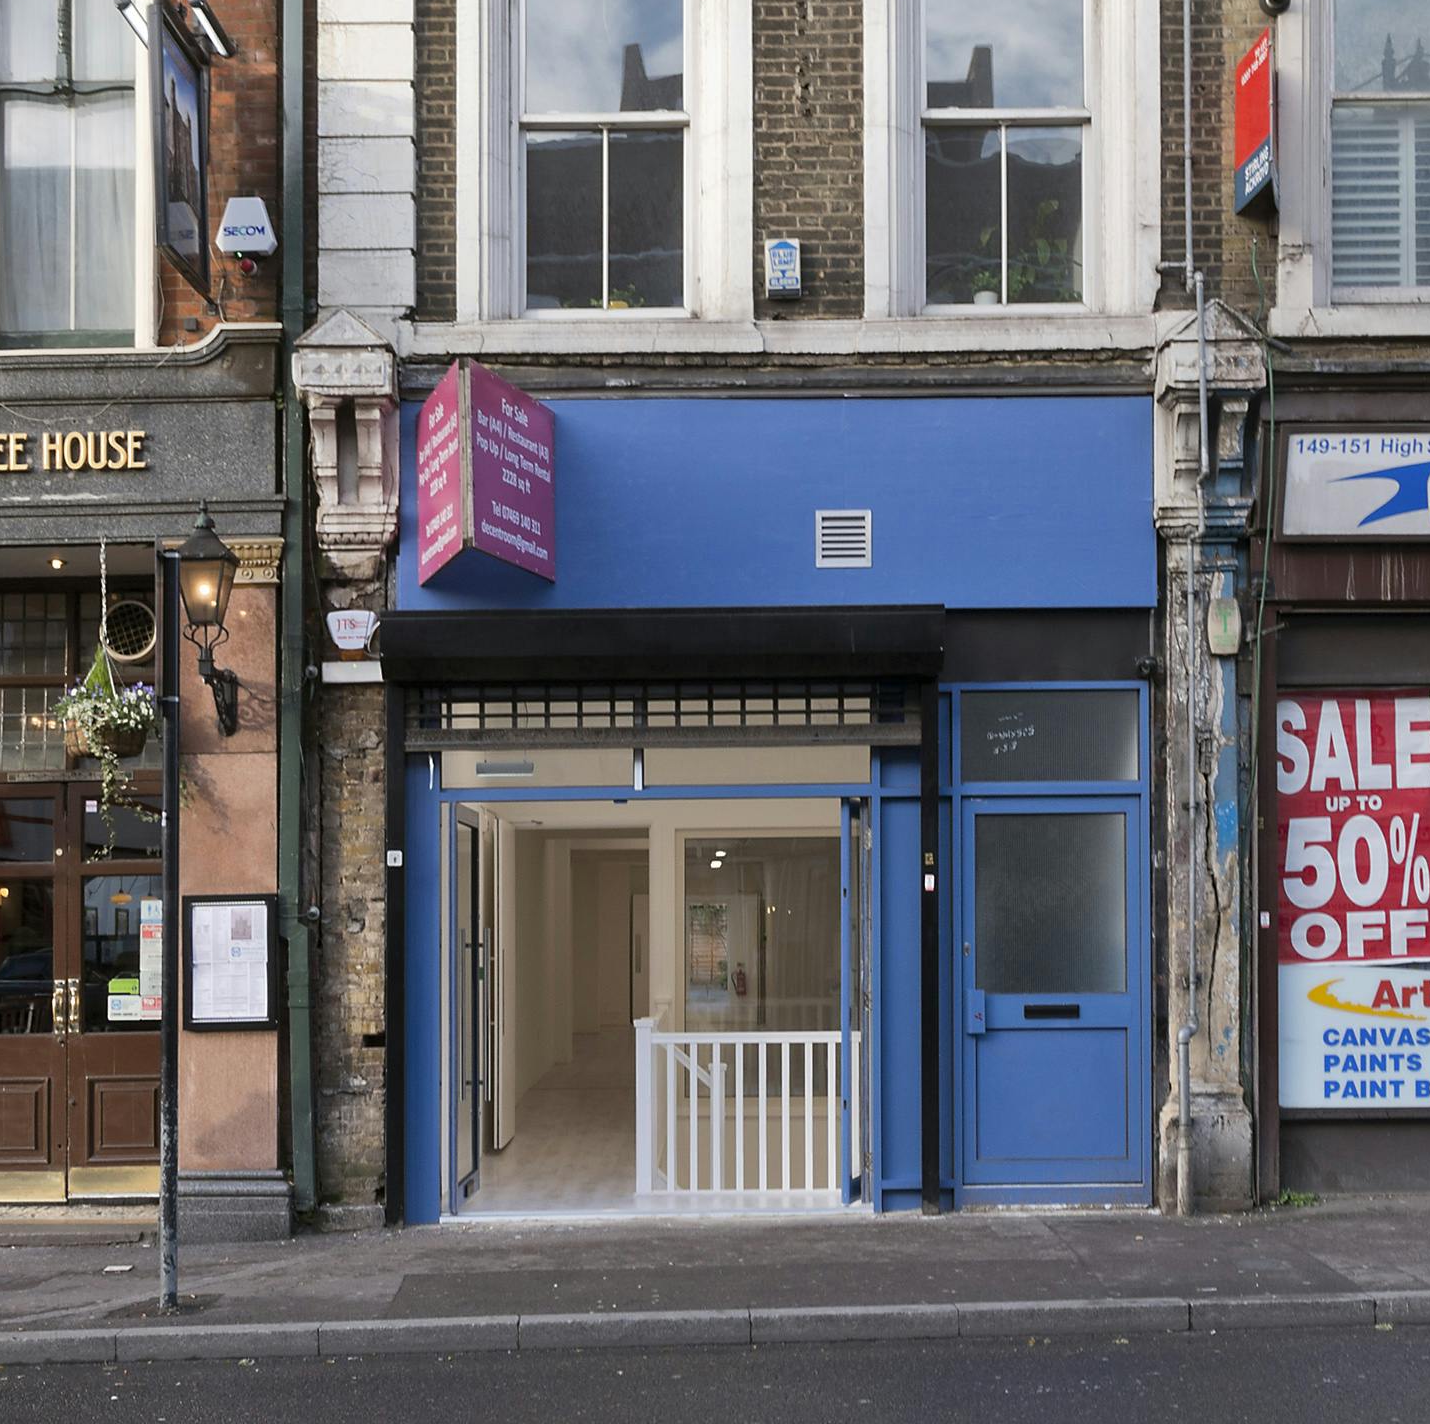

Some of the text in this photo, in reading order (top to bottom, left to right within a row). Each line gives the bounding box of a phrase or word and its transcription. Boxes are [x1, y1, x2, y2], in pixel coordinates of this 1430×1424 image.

[223, 225, 266, 237] SECOM
[501, 398, 529, 428] For Sale
[477, 409, 489, 426] Bar
[489, 415, 502, 435] (A4)
[507, 426, 538, 456] Restaurant
[42, 430, 148, 471] HOUSE
[476, 433, 488, 455] Pop
[488, 440, 500, 461] Up
[504, 446, 520, 471] Long
[519, 454, 534, 474] Term
[534, 461, 552, 483] Rental
[1295, 438, 1371, 455] 149-151
[1380, 437, 1424, 458] High
[517, 476, 525, 494] sq
[524, 479, 532, 495] ft
[491, 500, 502, 516] Tel
[1325, 794, 1383, 813] UP TO
[1282, 812, 1430, 910] 50%
[1290, 908, 1430, 961] OFF
[1323, 1053, 1422, 1073] PAINTS
[1323, 1079, 1405, 1099] PAINT
